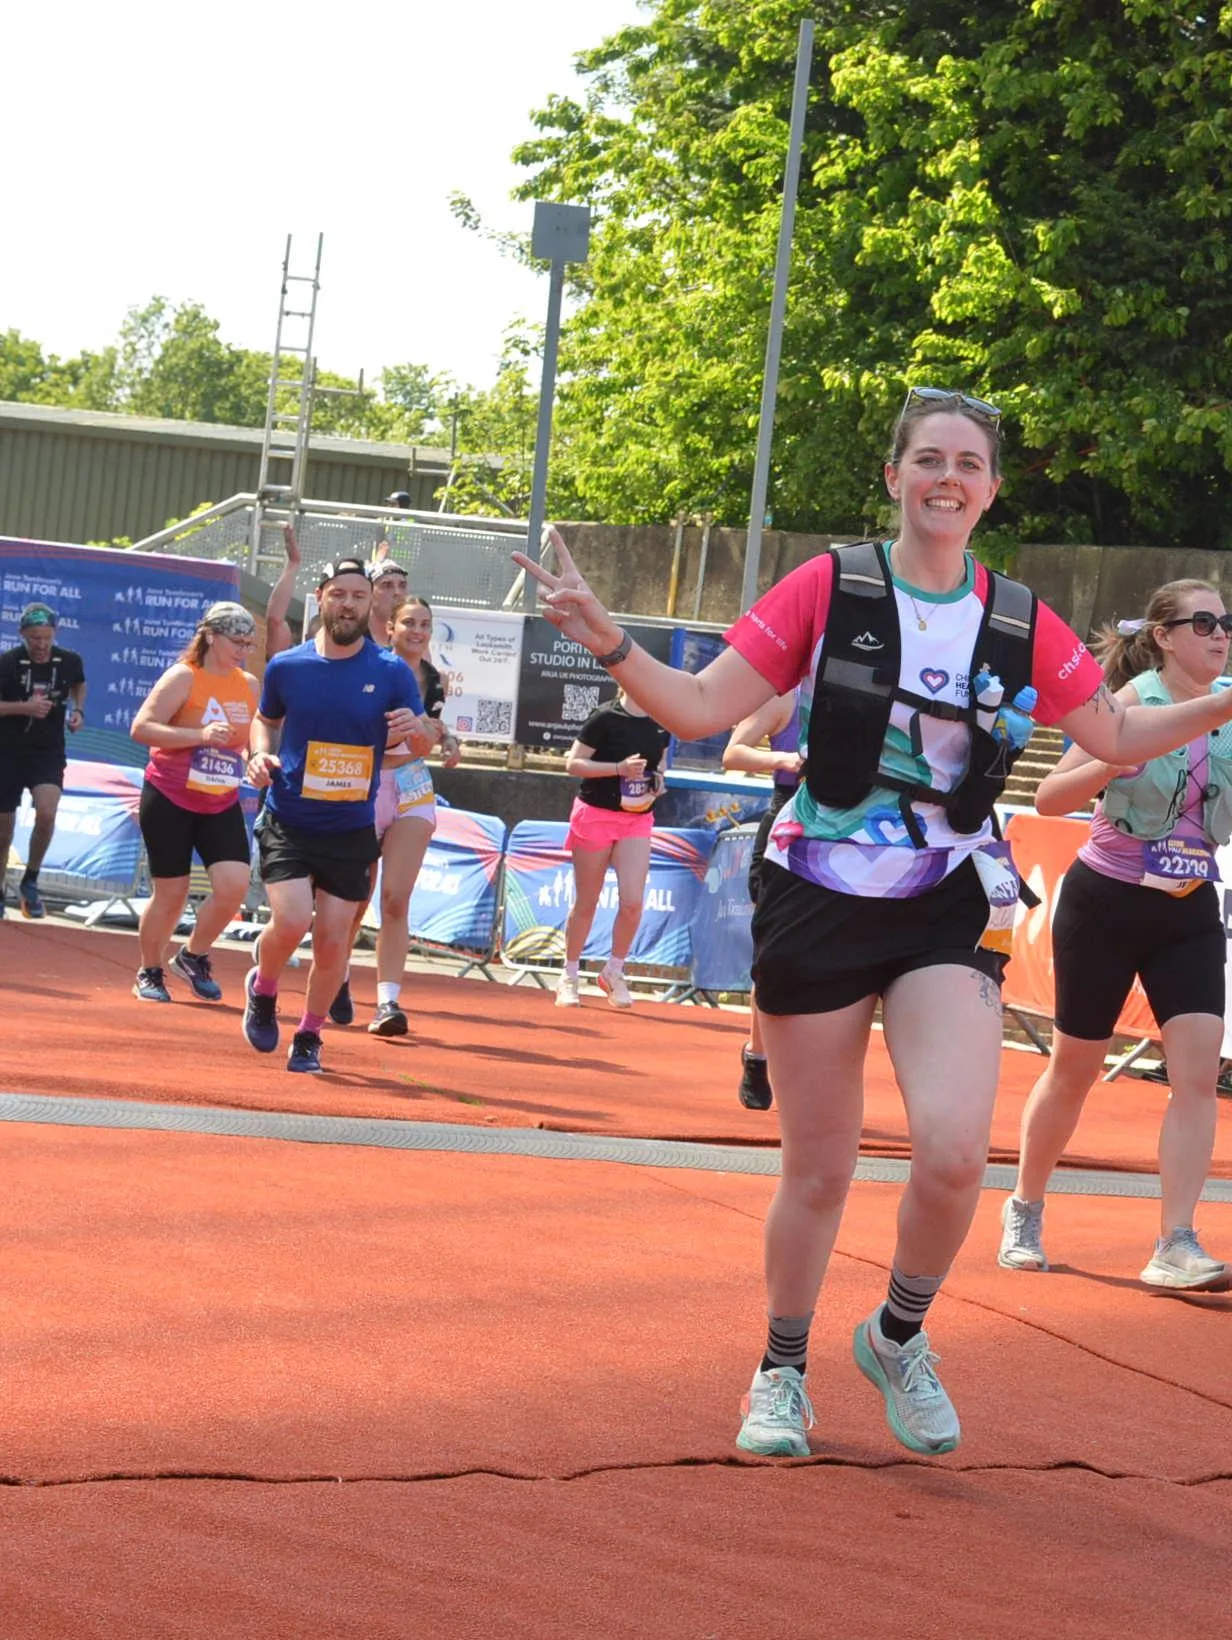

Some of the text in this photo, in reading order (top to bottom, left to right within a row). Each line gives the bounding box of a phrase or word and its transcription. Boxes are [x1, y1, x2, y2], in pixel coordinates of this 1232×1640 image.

[3, 580, 82, 599] RUN FOR ALL
[145, 595, 173, 607] RUN
[174, 598, 199, 609] FOR
[58, 617, 80, 629] ALL
[142, 626, 170, 638] RUN
[140, 656, 166, 668] RUN
[530, 652, 575, 666] STUDIO
[578, 657, 590, 669] IN
[200, 756, 235, 775] 21436
[318, 758, 363, 776] 25368
[644, 888, 676, 912] ALL
